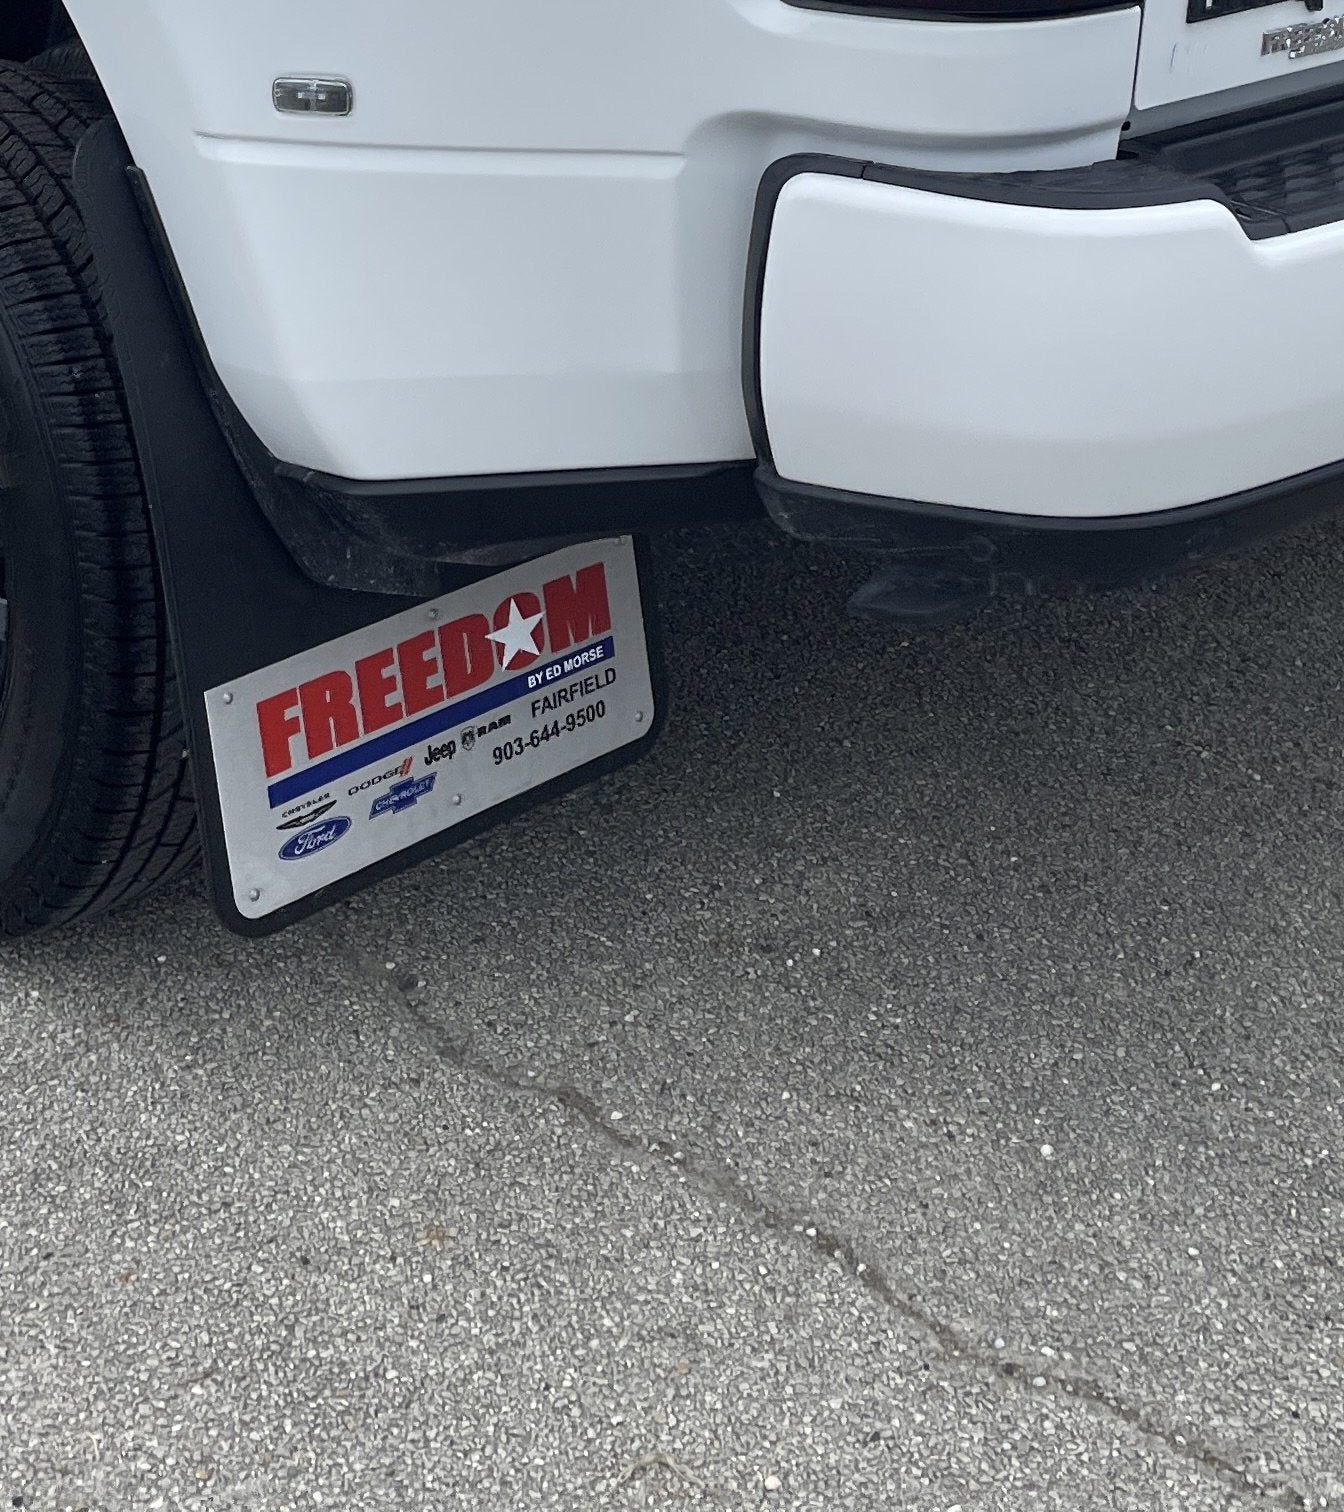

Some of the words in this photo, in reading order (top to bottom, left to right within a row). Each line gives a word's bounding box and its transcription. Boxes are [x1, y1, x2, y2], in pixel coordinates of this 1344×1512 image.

[256, 561, 612, 778] FREEDOM
[528, 671, 544, 689] BY
[545, 663, 562, 681] ED
[563, 645, 604, 673] MORSE
[424, 740, 456, 766] Jeep
[478, 714, 512, 738] RAM
[531, 667, 617, 719] FAIRFIELD
[492, 699, 606, 766] 903-644-9500
[293, 825, 337, 855] Ford
